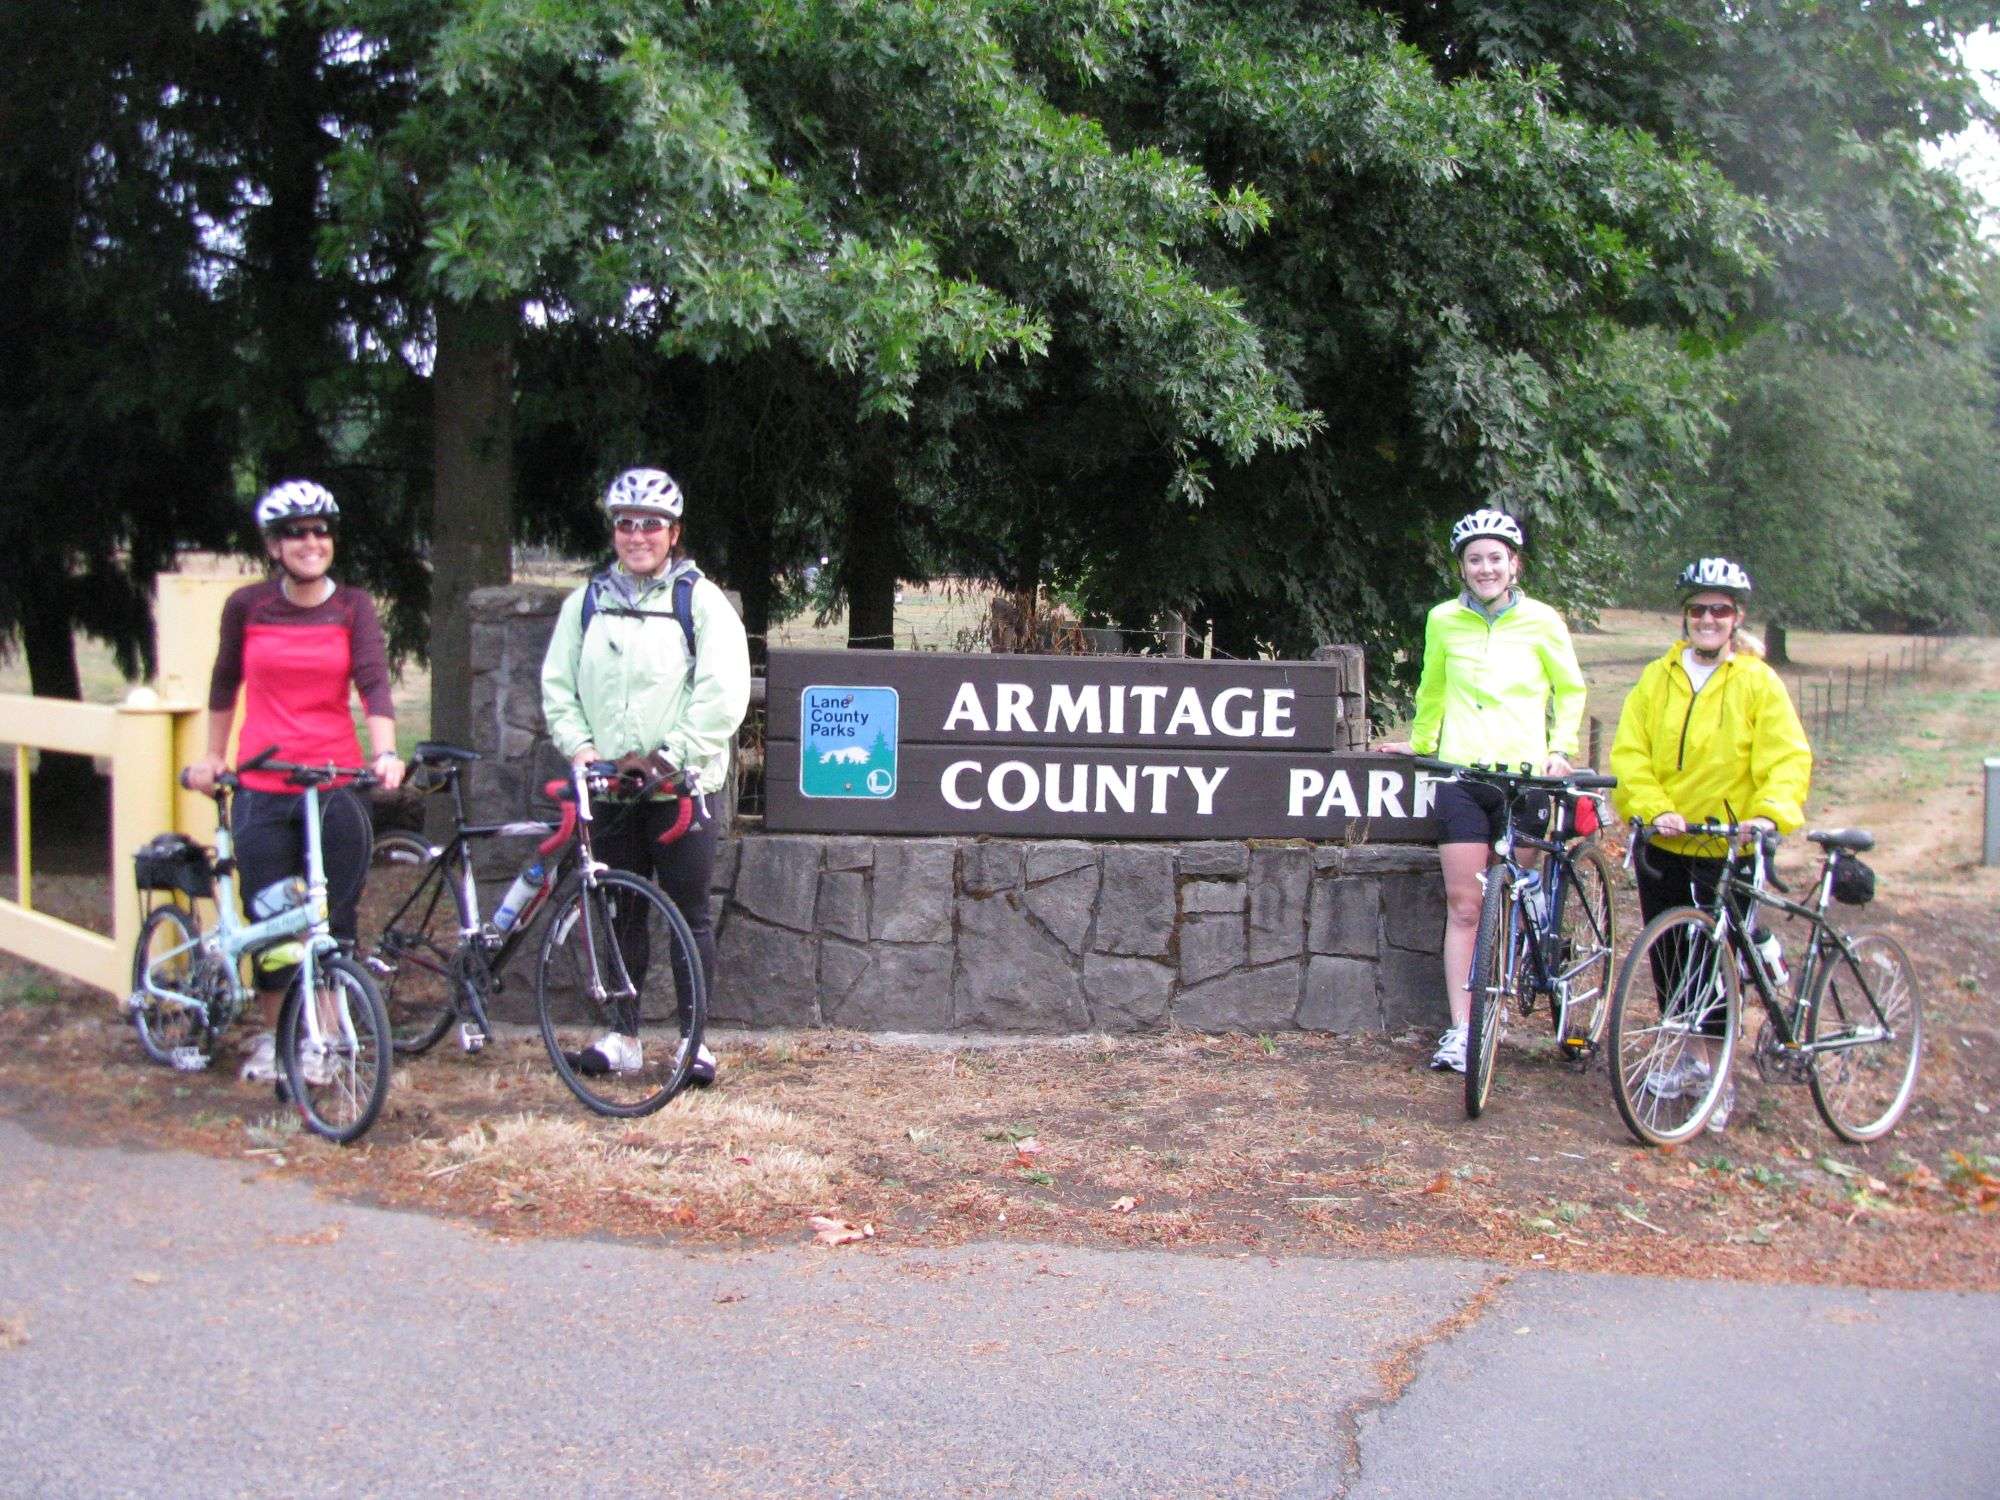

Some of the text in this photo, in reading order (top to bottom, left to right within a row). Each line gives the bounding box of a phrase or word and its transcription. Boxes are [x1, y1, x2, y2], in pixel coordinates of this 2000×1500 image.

[811, 695, 850, 709] Lane
[942, 682, 1296, 738] ARMITAGE
[811, 709, 869, 725] County
[810, 723, 855, 737] Parks
[940, 760, 1230, 815] COUNTY
